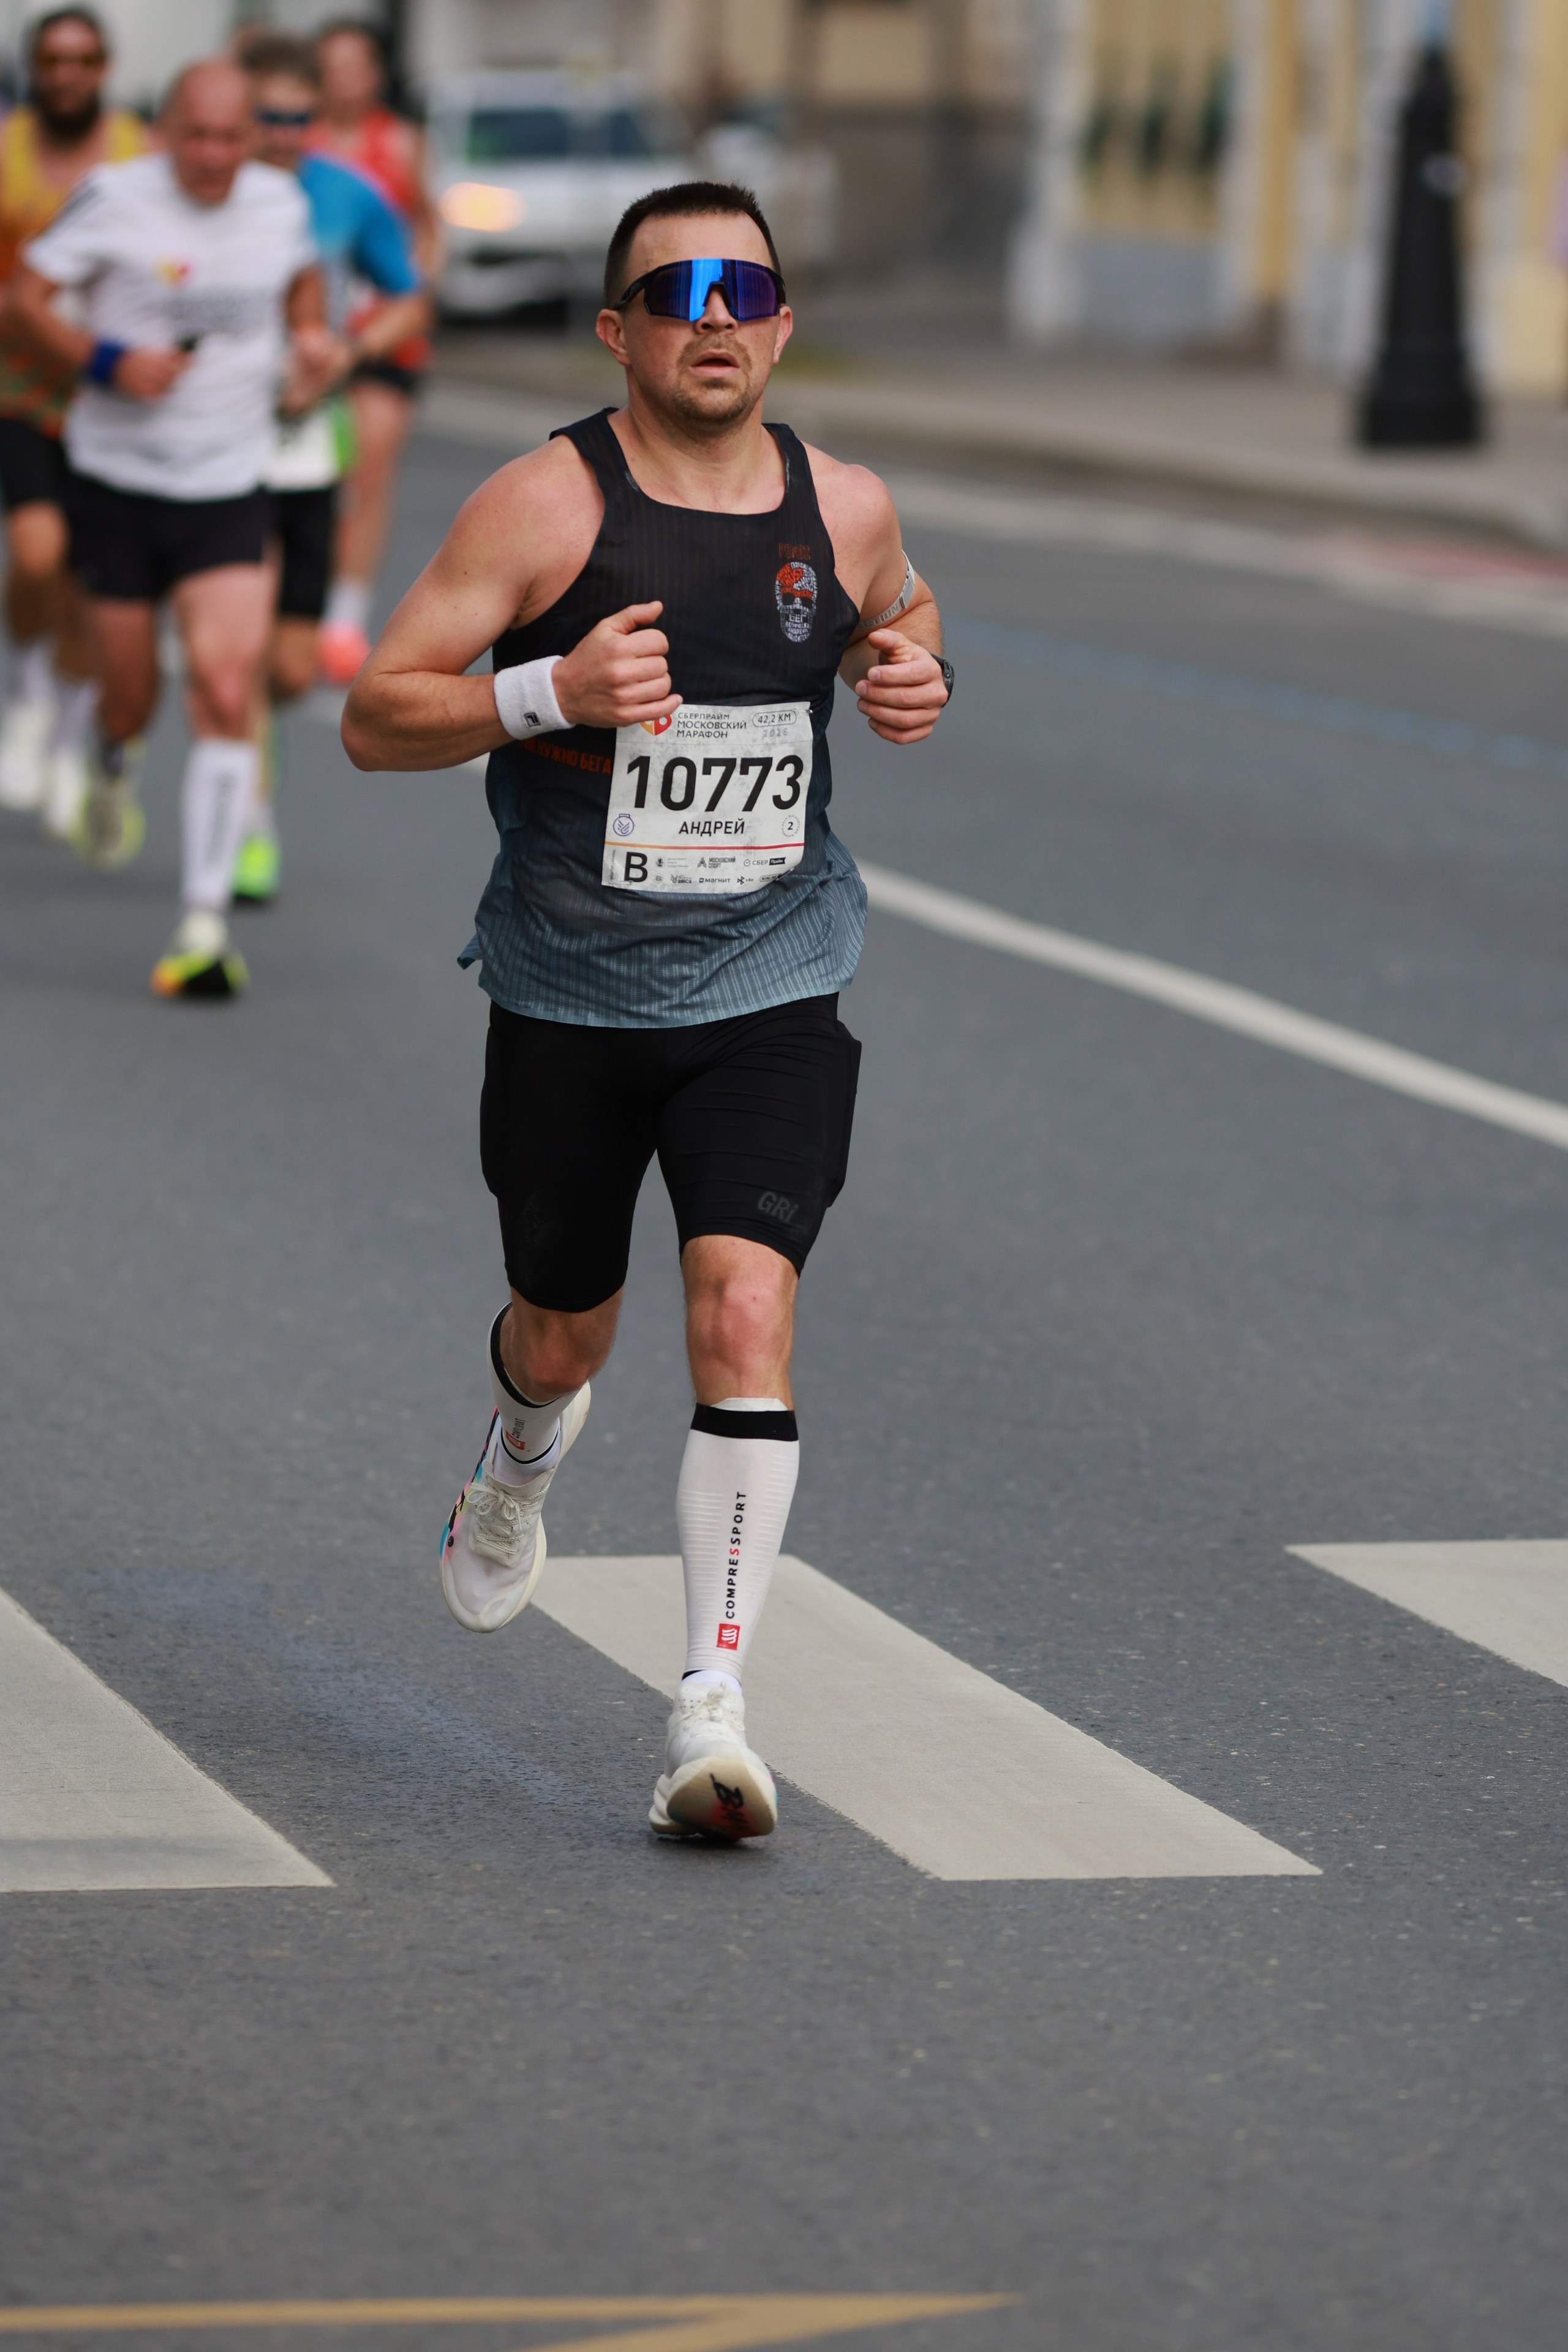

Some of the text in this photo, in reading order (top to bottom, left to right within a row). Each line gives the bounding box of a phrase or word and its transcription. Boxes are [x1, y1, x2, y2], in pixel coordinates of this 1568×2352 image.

[788, 614, 807, 623] БЕГ
[758, 714, 775, 724] 42,2
[677, 720, 747, 729] МОСКОВСКИЙ
[627, 754, 804, 812] 10773
[679, 818, 745, 837] АНДРЕЙ
[787, 821, 793, 831] 2
[725, 1491, 746, 1619] COMPRESSPORT
